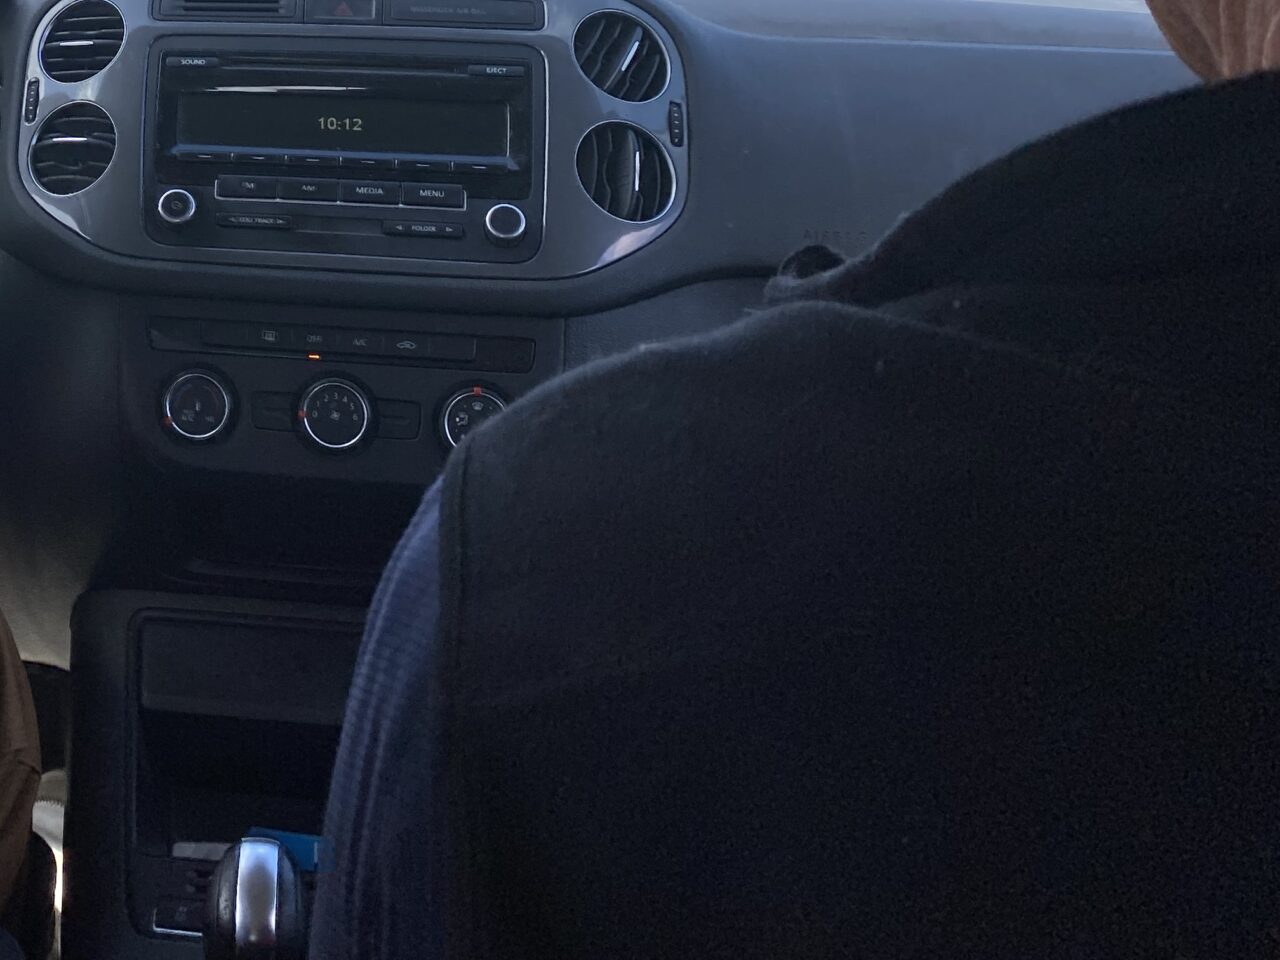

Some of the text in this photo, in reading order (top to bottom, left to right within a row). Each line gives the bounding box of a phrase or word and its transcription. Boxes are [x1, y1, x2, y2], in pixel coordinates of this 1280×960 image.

[181, 58, 206, 66] SOUND
[486, 66, 507, 74] EJECT
[318, 117, 362, 131] 10:12
[356, 186, 384, 195] MEDIA
[419, 189, 445, 198] MENU
[412, 224, 437, 232] FOLDER
